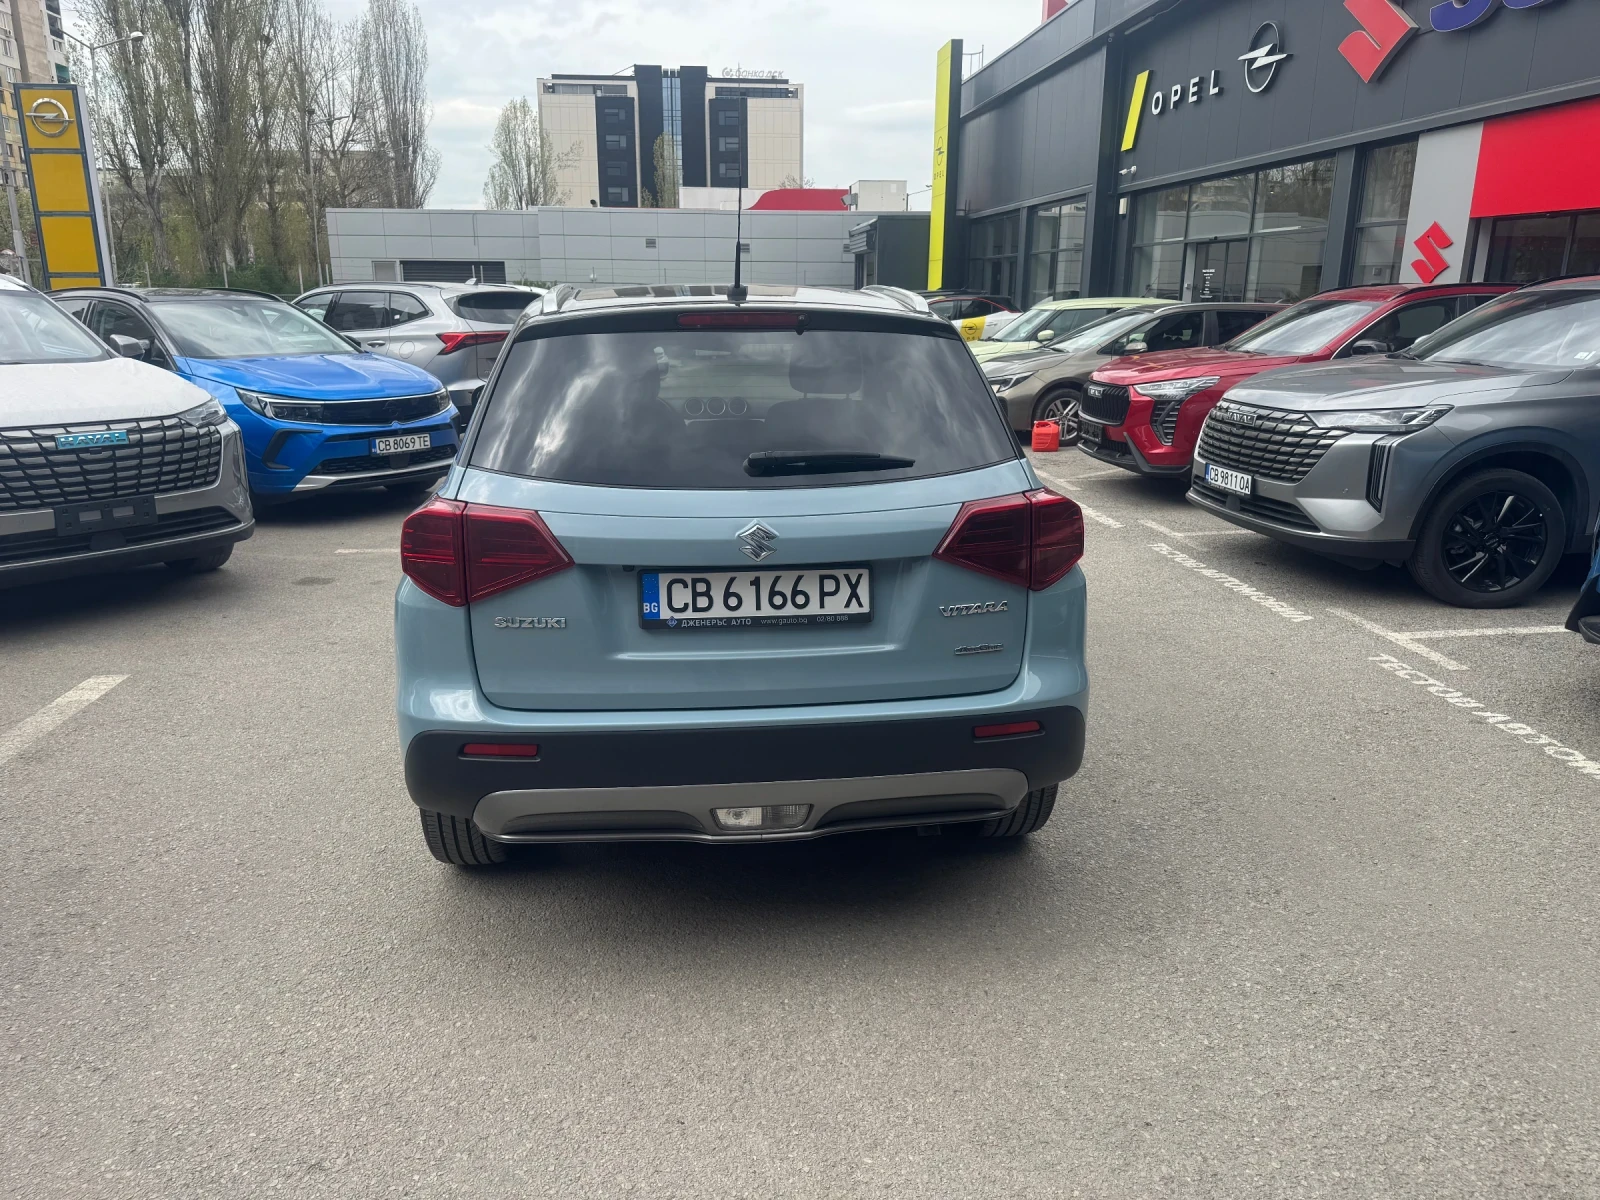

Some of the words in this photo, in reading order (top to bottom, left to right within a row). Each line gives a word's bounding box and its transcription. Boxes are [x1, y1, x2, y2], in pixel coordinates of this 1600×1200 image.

[1151, 69, 1220, 115] OPEL
[60, 433, 126, 447] HAVAL
[378, 440, 391, 452] CB
[393, 437, 416, 450] 8069
[417, 435, 429, 447] TE
[1209, 467, 1219, 482] CB
[1220, 468, 1238, 489] 9811
[666, 578, 714, 613] CB
[722, 575, 811, 612] 6166
[818, 573, 864, 609] PX
[643, 603, 658, 613] BG
[939, 600, 1008, 617] VITARA
[494, 616, 566, 628] SUZUKI
[731, 618, 752, 626] АУТО
